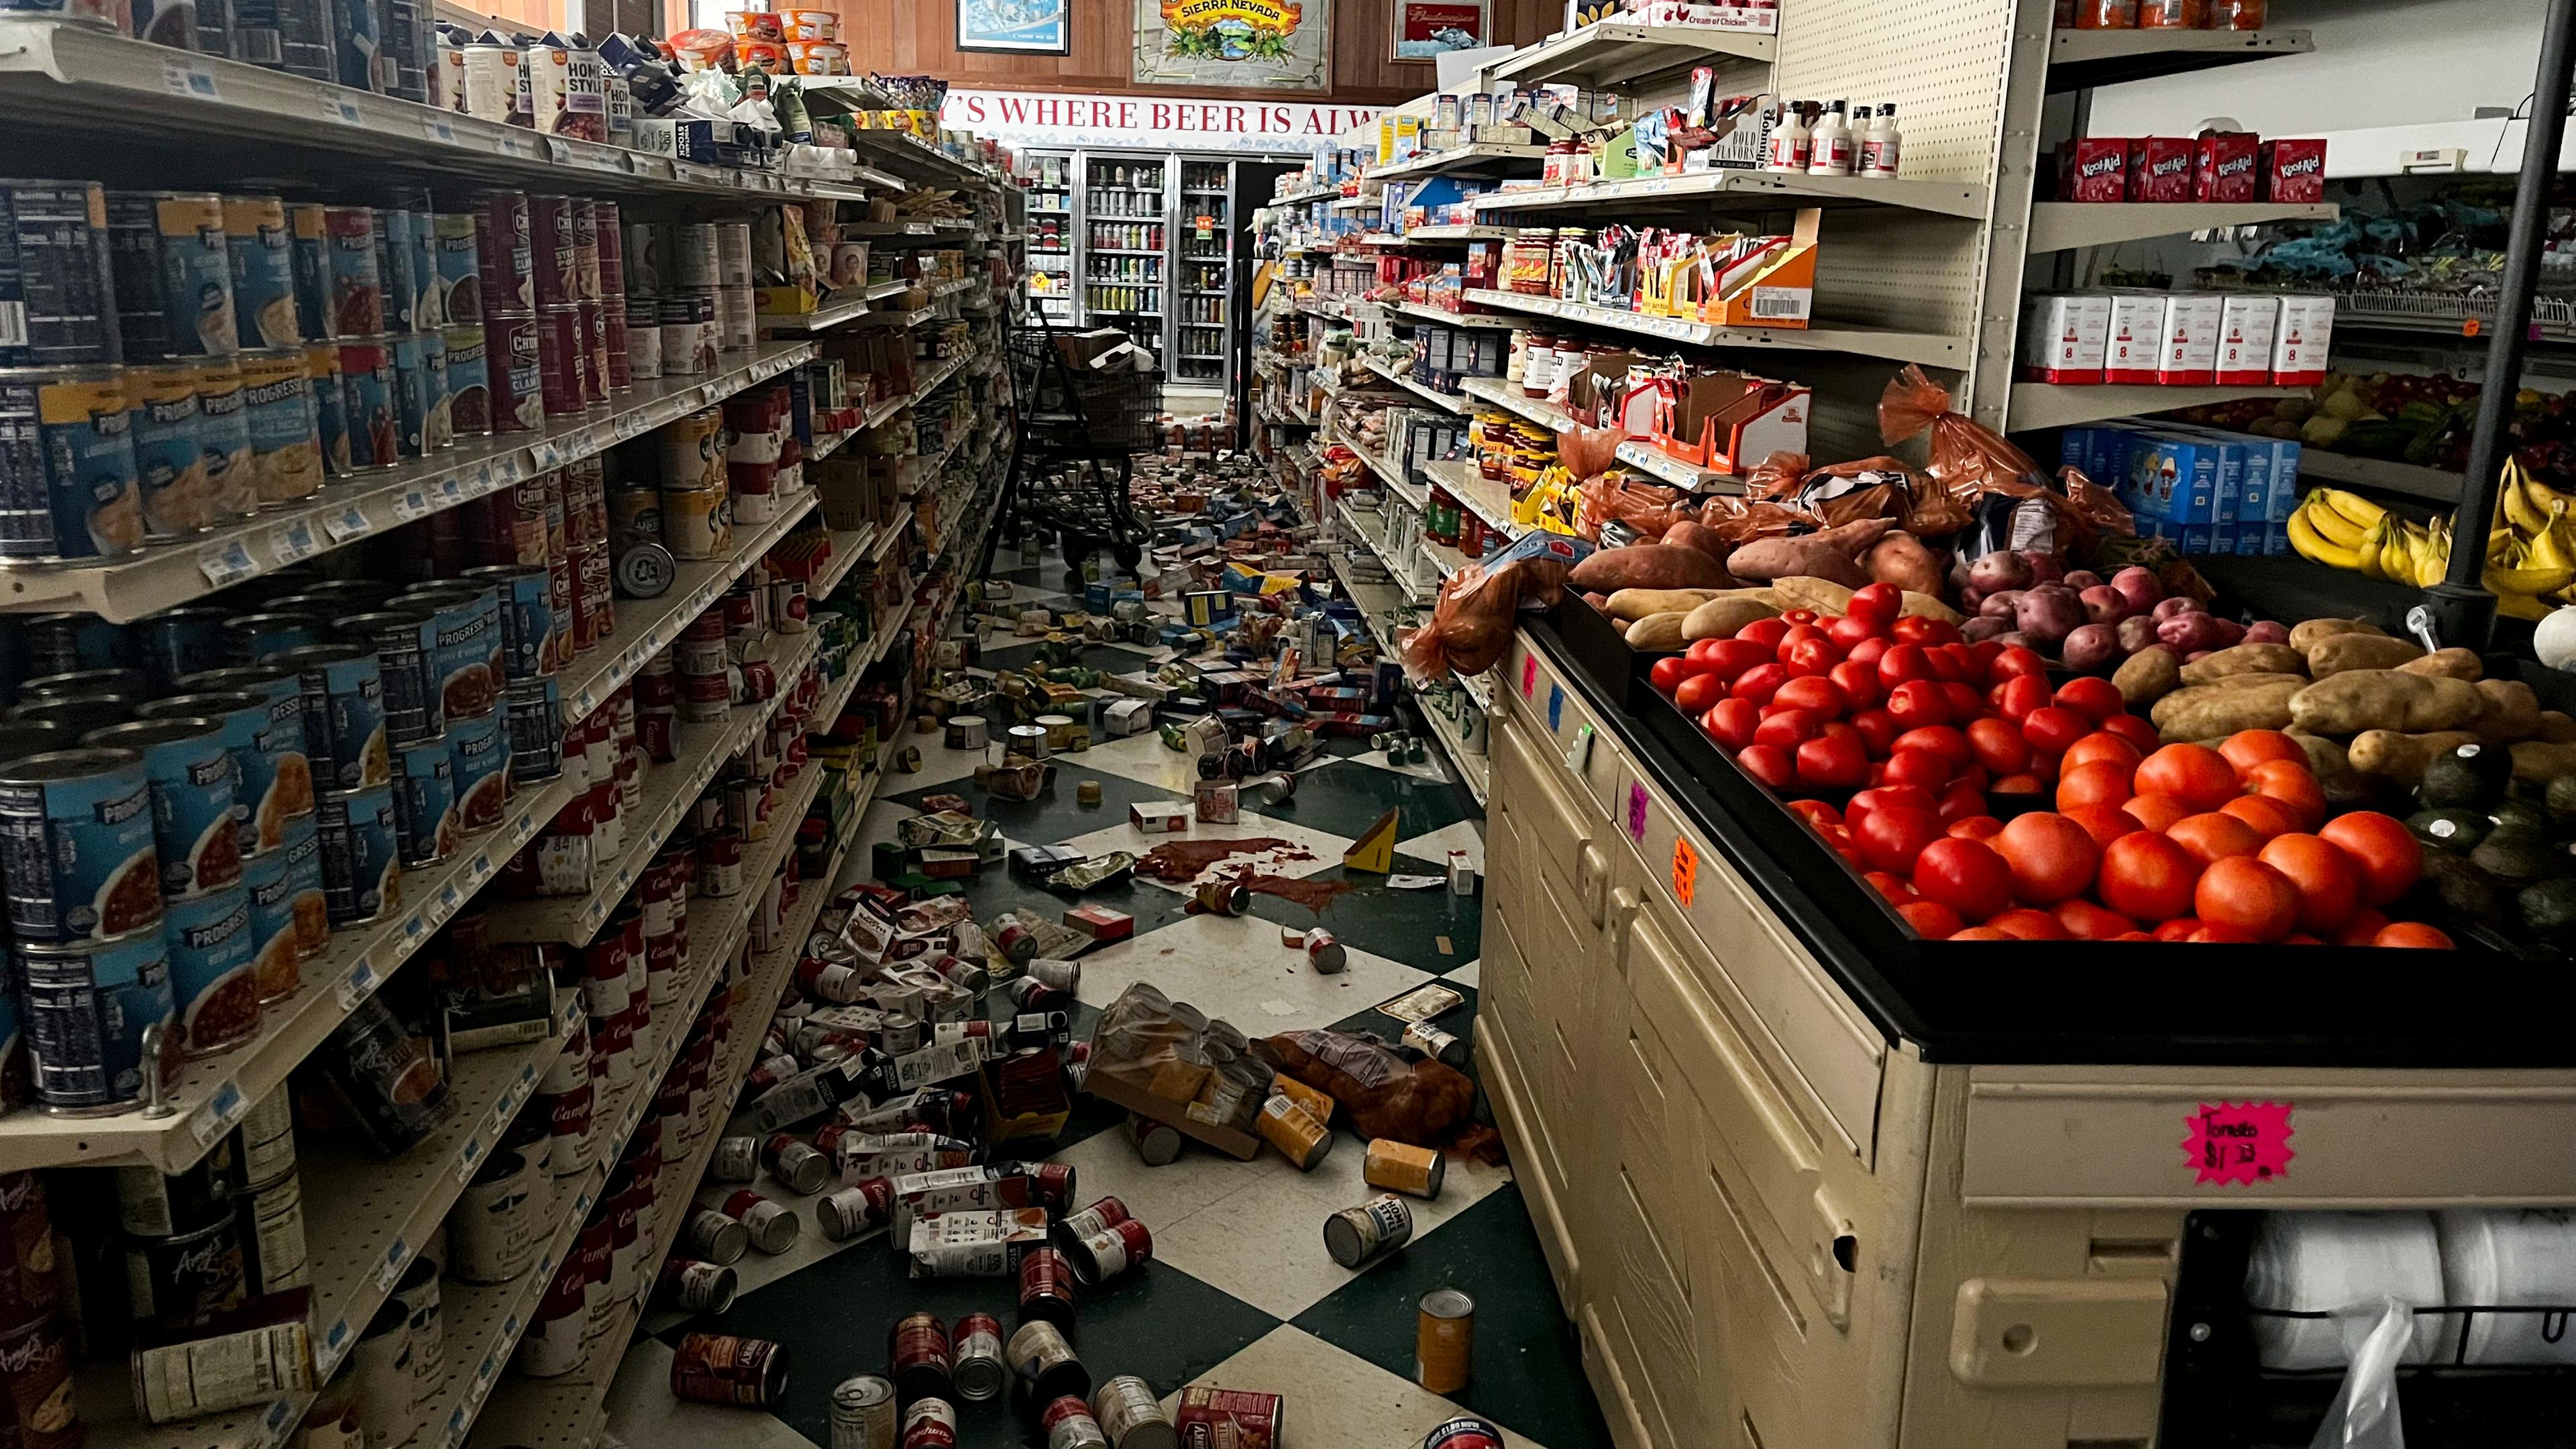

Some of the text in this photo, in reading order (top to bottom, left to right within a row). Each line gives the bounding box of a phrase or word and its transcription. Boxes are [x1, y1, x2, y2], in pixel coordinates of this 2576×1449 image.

[1182, 1, 1280, 21] SIERRA NEVADA
[1689, 16, 1712, 26] Cream
[1713, 17, 1721, 25] of
[1721, 17, 1748, 27] Chicken
[998, 98, 1138, 129] WHERE
[1150, 103, 1248, 133] BEER
[1258, 107, 1292, 133] IS
[678, 125, 686, 159] STOCK
[1733, 131, 1756, 146] BOLD
[1715, 144, 1755, 160] FLAVORS
[2082, 153, 2121, 177] Kool-Aid
[2152, 154, 2187, 177] Kool-Aid
[2218, 154, 2252, 177] Kool-Aid
[2281, 155, 2320, 178] Kool-Aid
[2065, 347, 2073, 359] 8
[2119, 346, 2128, 358] 8
[2175, 348, 2184, 360] 8
[2229, 347, 2237, 360] 8
[2288, 349, 2297, 361] 8
[2200, 1110, 2258, 1138] Tomato
[1378, 1205, 1397, 1234] STYLE
[1385, 1201, 1405, 1230] HOME
